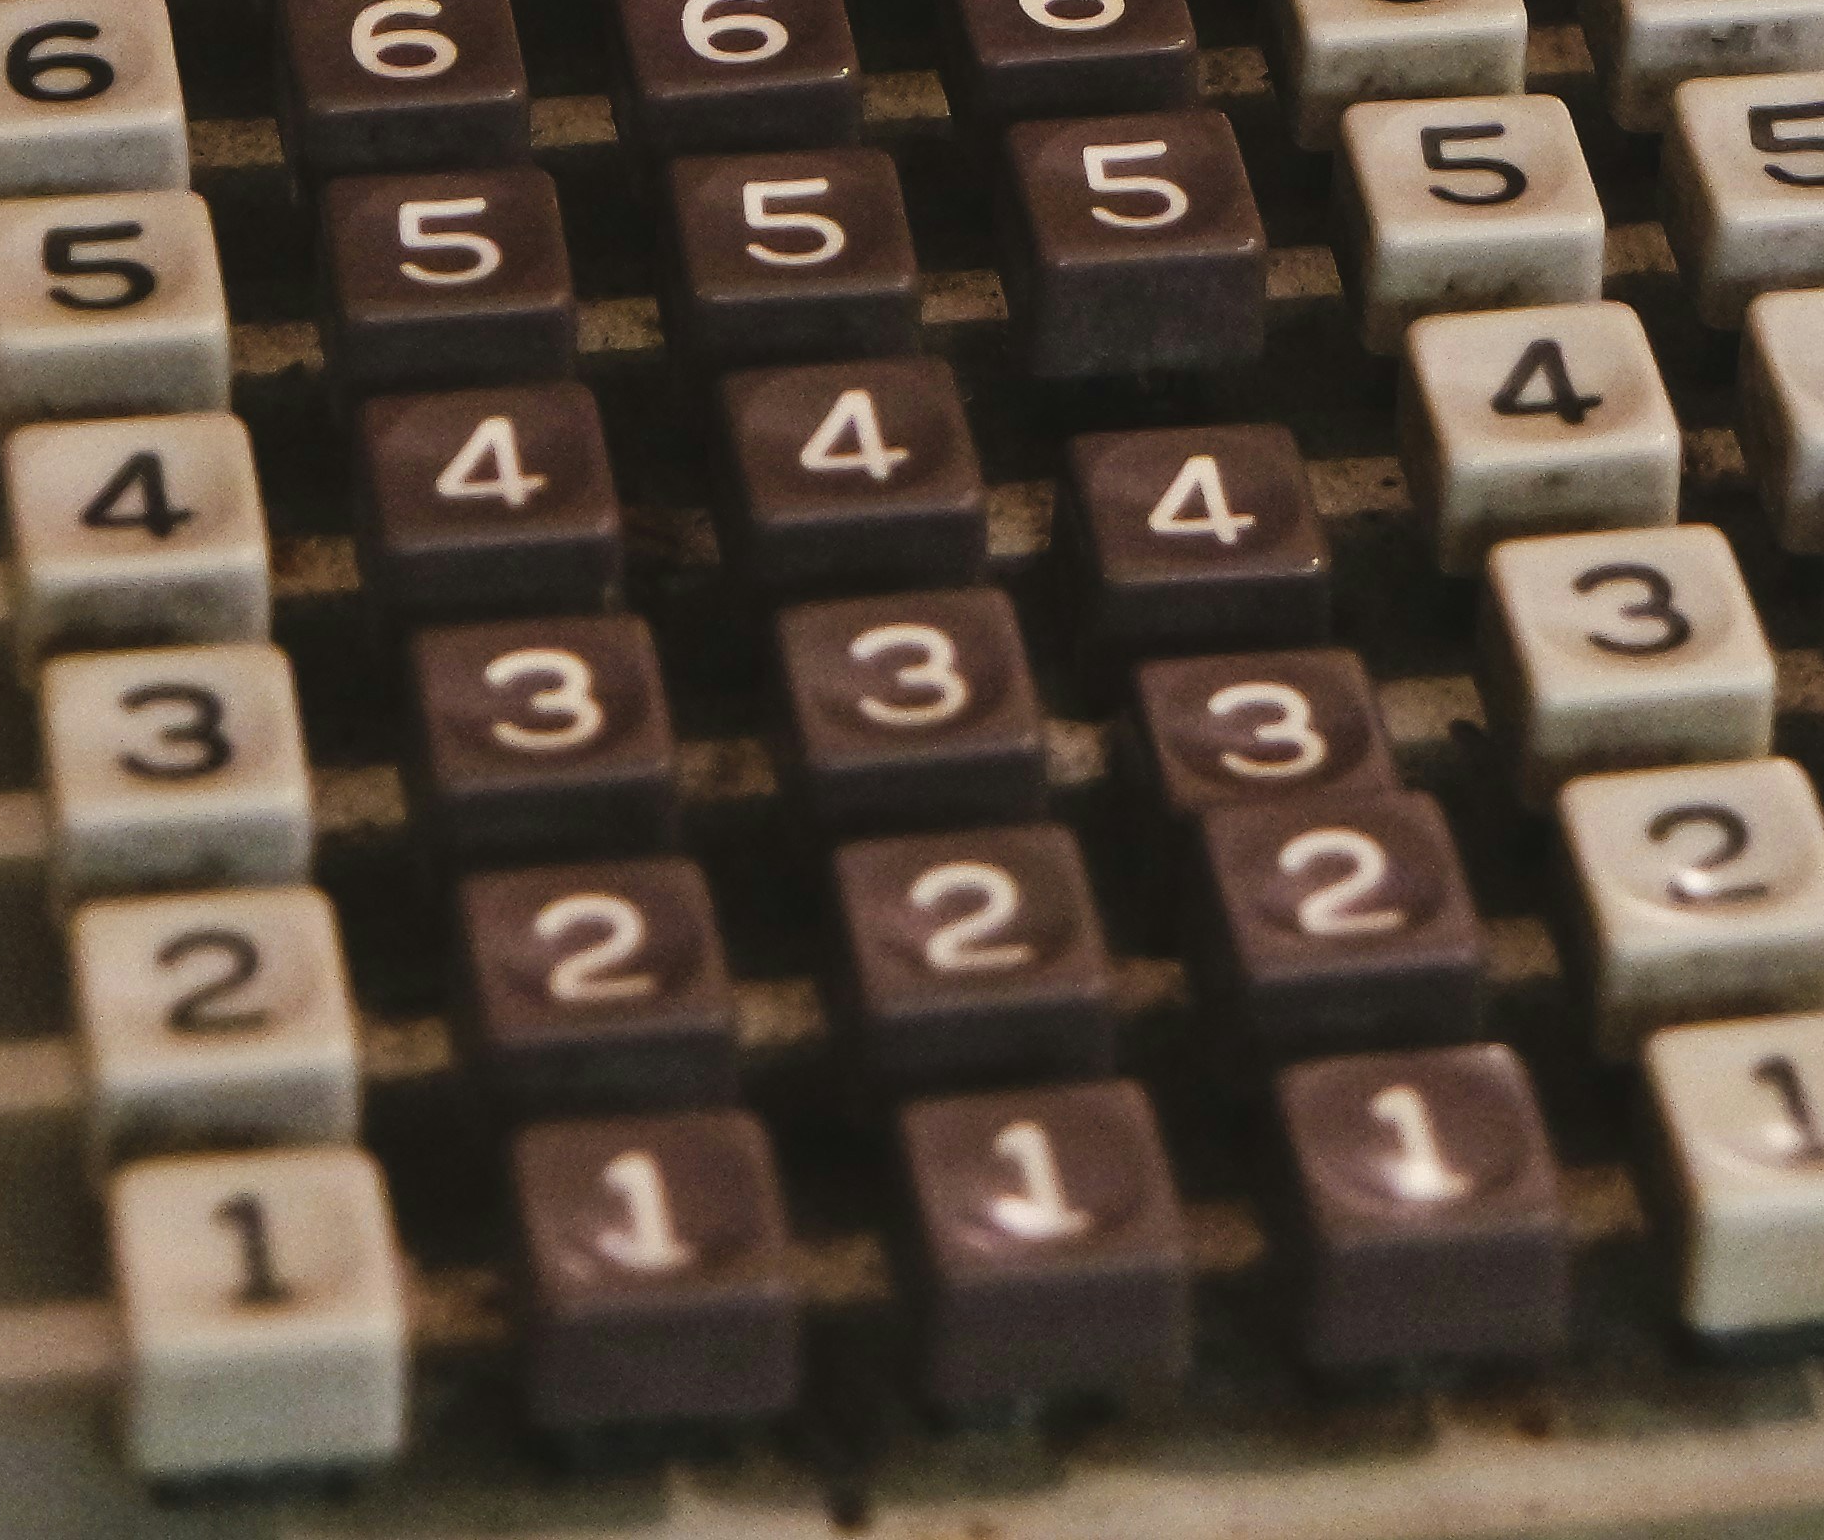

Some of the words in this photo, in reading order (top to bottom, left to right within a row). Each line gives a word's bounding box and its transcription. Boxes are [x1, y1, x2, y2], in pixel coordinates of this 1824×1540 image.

[6, 20, 114, 101] 6
[1082, 140, 1187, 228] 5
[1421, 124, 1527, 204] 5
[42, 221, 155, 309] 5
[398, 198, 503, 284] 5
[742, 177, 846, 265] 5
[1490, 338, 1603, 425] 4
[436, 417, 548, 506] 4
[799, 389, 910, 478] 4
[81, 451, 192, 537] 4
[1147, 454, 1253, 545] 4
[1573, 564, 1690, 656] 3
[484, 649, 604, 750] 3
[848, 624, 970, 723] 3
[117, 683, 231, 779] 3
[1206, 683, 1325, 777] 3
[1277, 828, 1400, 936] 2
[1649, 805, 1767, 904] 2
[533, 893, 656, 1000] 2
[909, 862, 1031, 971] 2
[155, 928, 264, 1034] 2
[987, 1123, 1092, 1240] 1
[1371, 1085, 1467, 1203] 1
[210, 1192, 286, 1309] 1
[597, 1150, 696, 1270] 1
